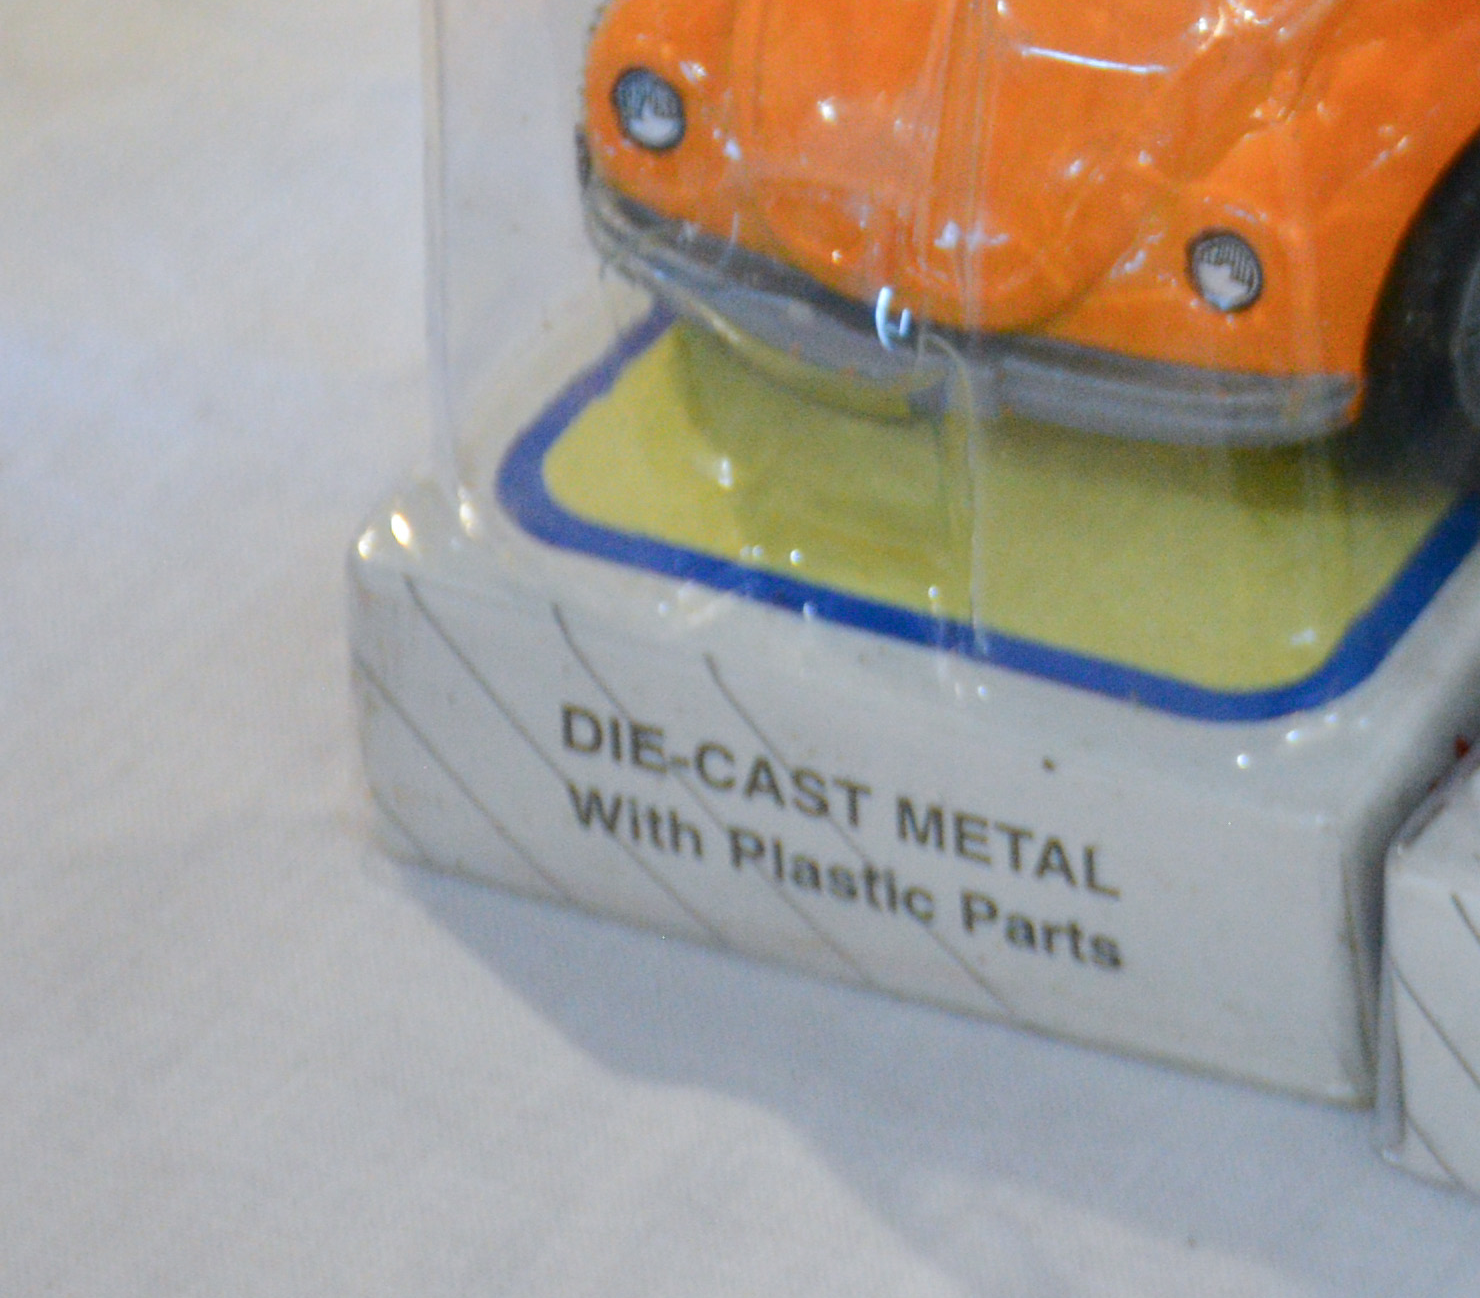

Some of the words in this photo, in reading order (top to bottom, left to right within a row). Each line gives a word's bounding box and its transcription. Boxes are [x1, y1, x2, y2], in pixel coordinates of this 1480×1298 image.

[561, 704, 872, 828] DIE-CAST
[896, 796, 1121, 899] METAL
[566, 782, 704, 859] With
[729, 825, 935, 923] Plastic
[961, 890, 1124, 970] Parts
